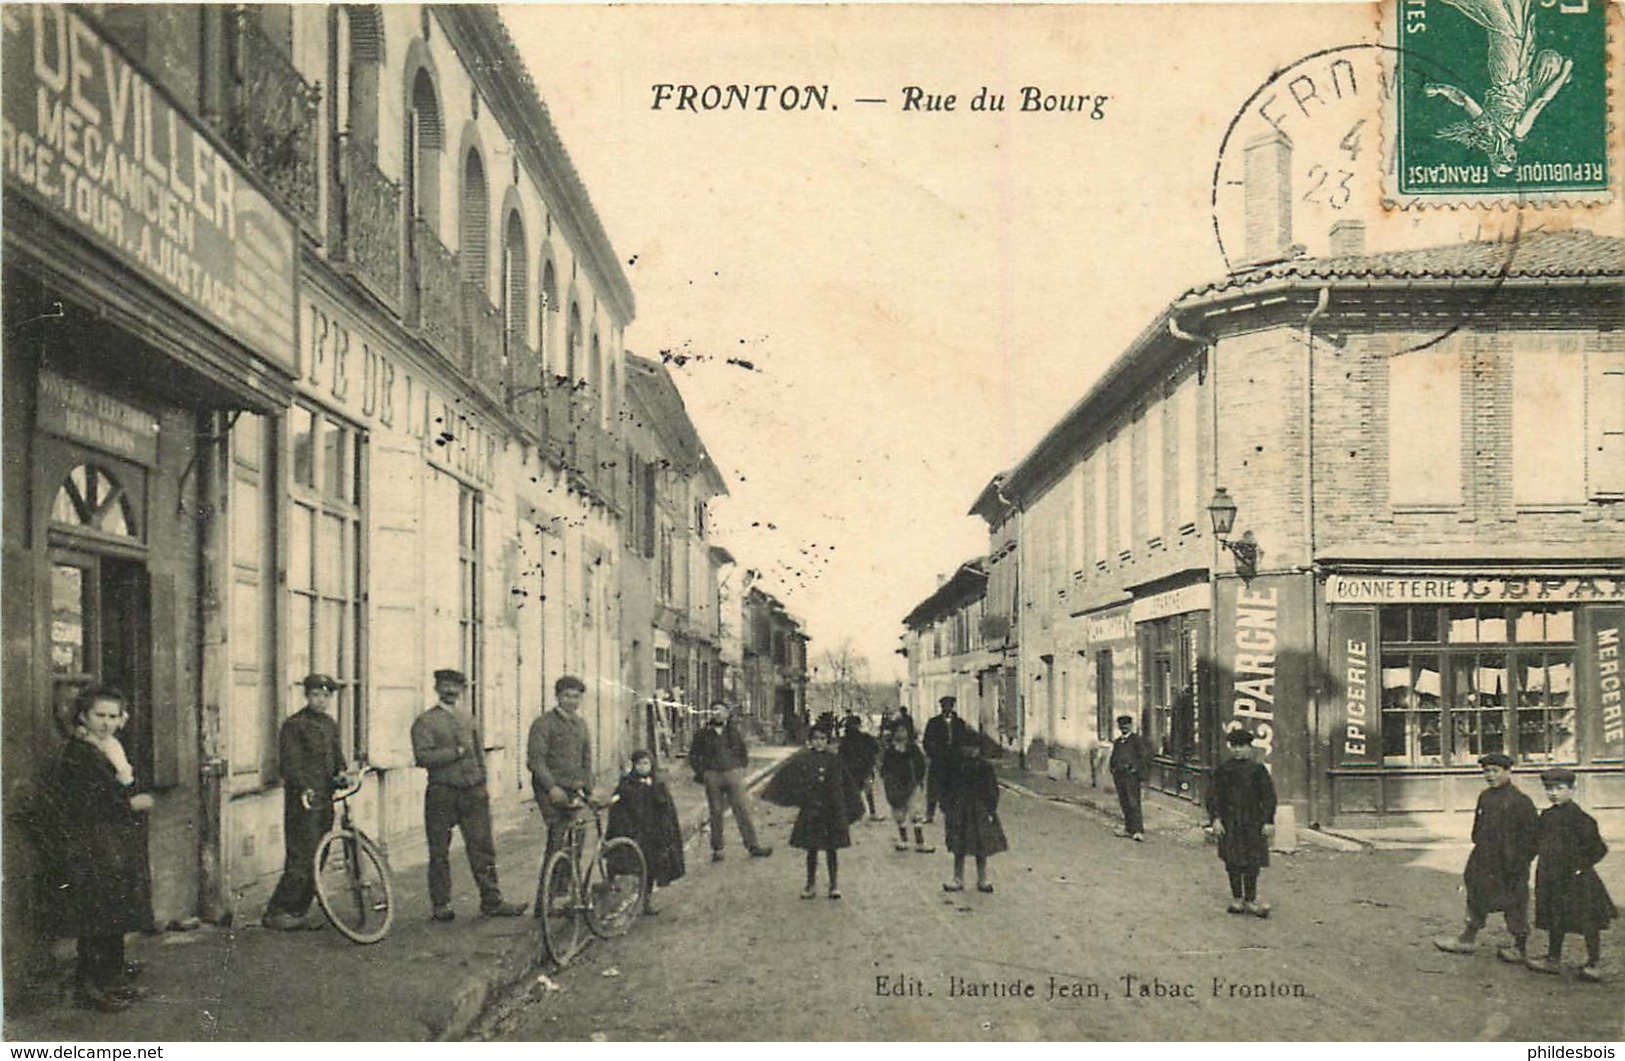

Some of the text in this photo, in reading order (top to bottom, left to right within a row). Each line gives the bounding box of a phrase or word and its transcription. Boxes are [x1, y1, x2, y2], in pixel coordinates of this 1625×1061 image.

[1337, 580, 1456, 599] BONNETERIE
[1344, 639, 1368, 756] EPICERIE
[1597, 628, 1625, 745] MERCERIE
